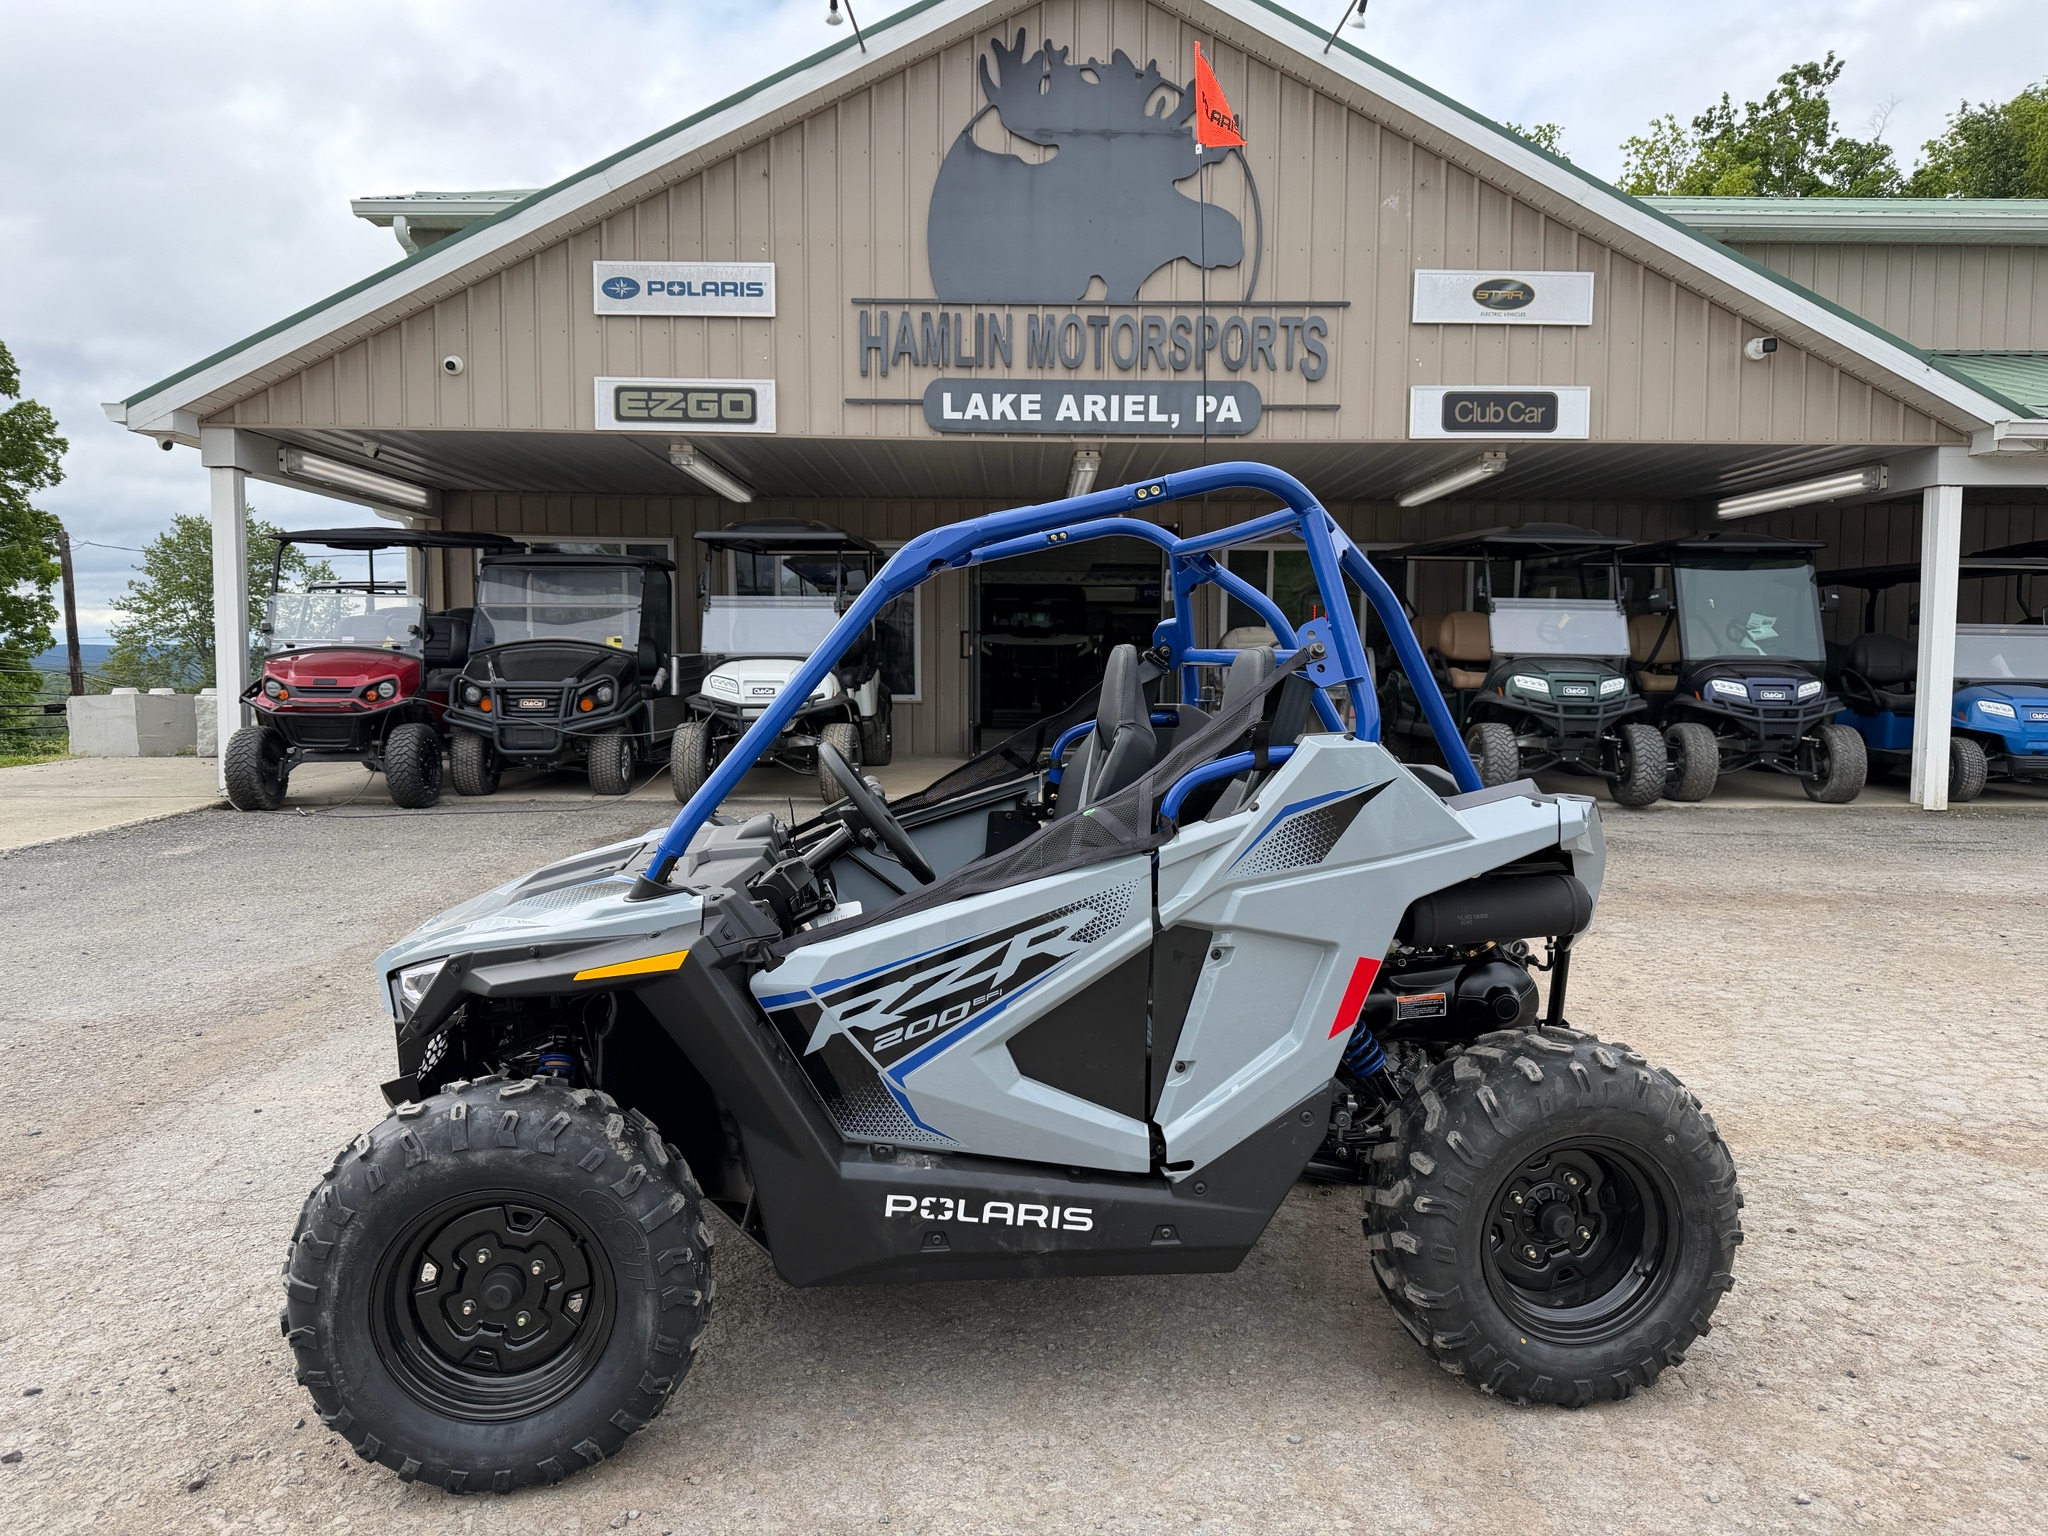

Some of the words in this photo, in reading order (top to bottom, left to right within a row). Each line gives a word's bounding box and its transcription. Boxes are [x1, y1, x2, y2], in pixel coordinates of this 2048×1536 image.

[647, 281, 764, 297] POLARIS
[1476, 290, 1523, 300] STAR
[859, 309, 1013, 377] HAMLIN
[1027, 313, 1329, 382] MOTORSPORTS
[619, 391, 752, 419] EZGO
[942, 391, 1042, 421] LAKE
[1055, 394, 1181, 430] ARIEL,
[1196, 395, 1242, 423] PA
[1454, 400, 1504, 423] Club
[1506, 400, 1546, 424] Car
[804, 908, 1100, 1057] RZR
[872, 1001, 971, 1052] 200
[884, 1194, 1094, 1232] POLARIS
[578, 1188, 657, 1291] CST
